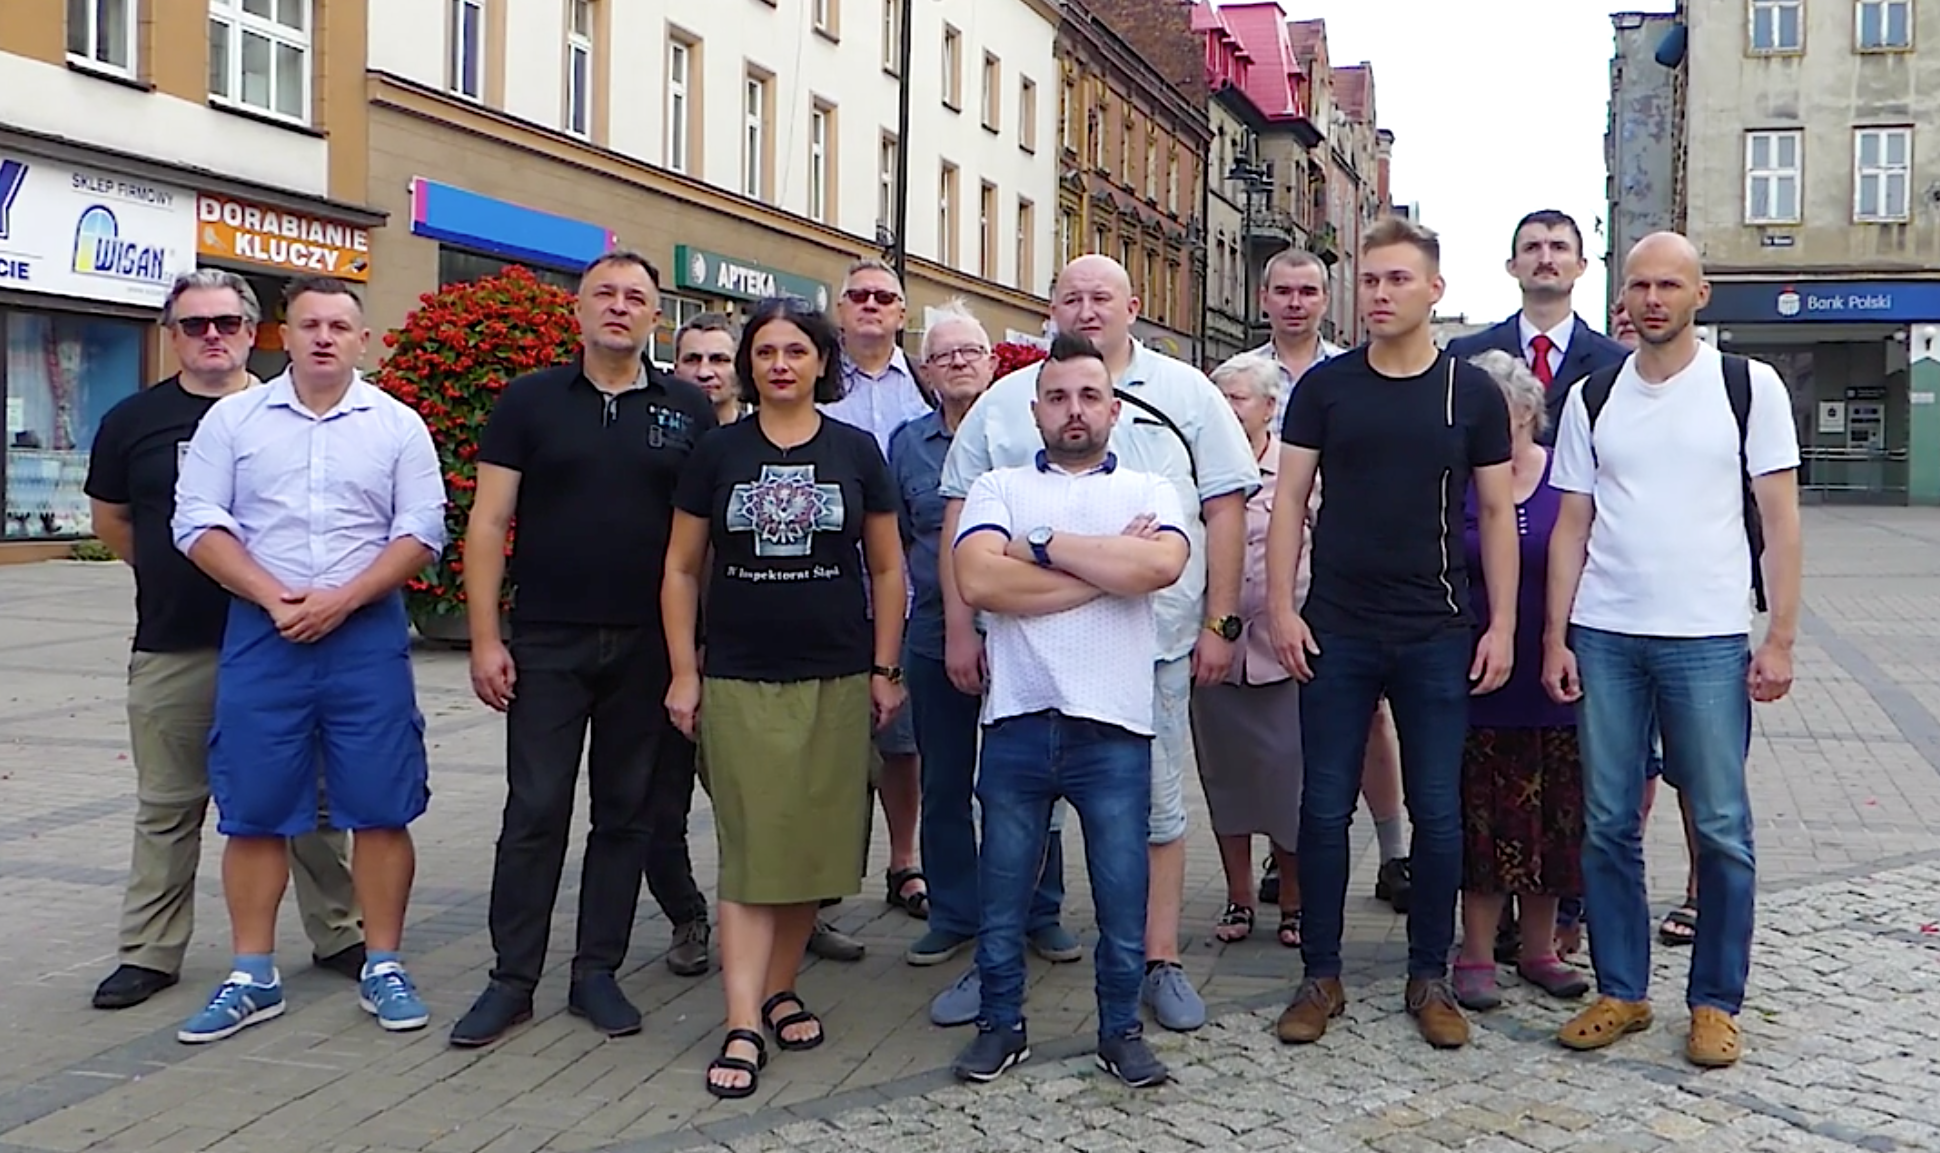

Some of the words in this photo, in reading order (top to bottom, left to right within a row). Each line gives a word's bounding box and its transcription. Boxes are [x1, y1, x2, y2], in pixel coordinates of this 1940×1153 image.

[72, 172, 114, 193] SKLEP
[117, 182, 174, 206] FIRMOWY
[199, 197, 369, 251] DORABIANIE
[95, 237, 165, 280] WISAN
[235, 231, 339, 271] KLUCZY
[717, 261, 777, 298] APTEKA
[1807, 294, 1845, 310] Bank
[1849, 294, 1892, 310] Polski
